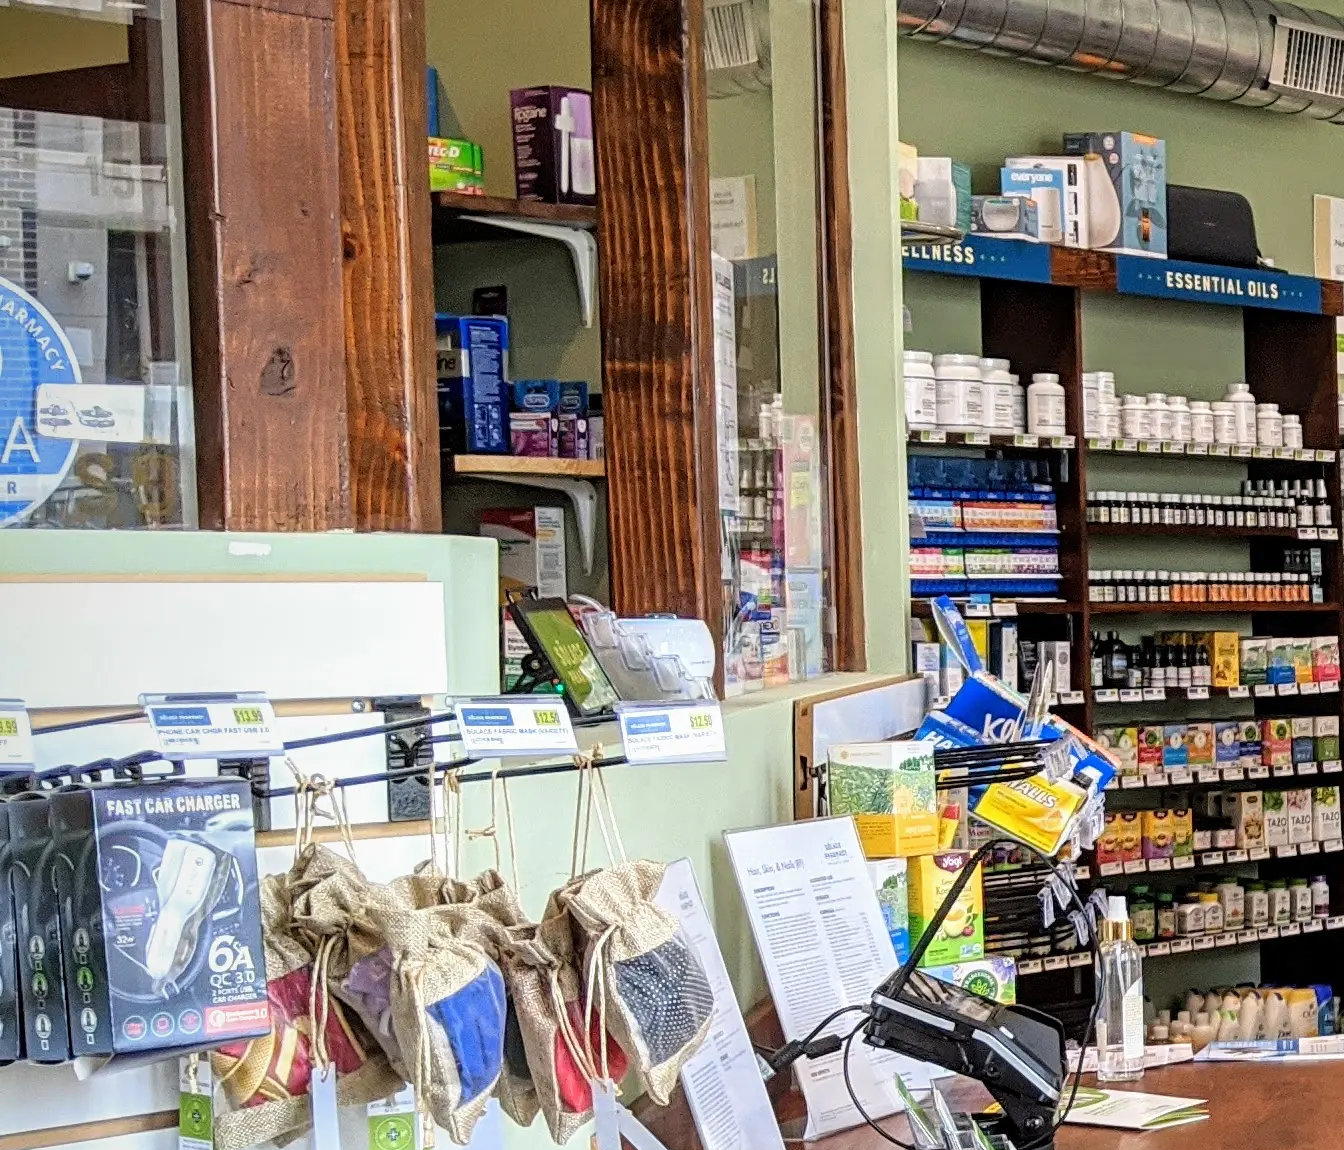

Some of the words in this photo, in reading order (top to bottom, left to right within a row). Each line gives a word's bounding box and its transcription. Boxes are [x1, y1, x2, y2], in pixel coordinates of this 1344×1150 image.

[1011, 171, 1053, 184] everyone
[902, 245, 974, 265] ELLNESS
[1166, 270, 1243, 296] ESSENTIAL
[1247, 278, 1279, 300] OILS
[234, 709, 263, 724] $13.99
[535, 711, 560, 725] $12.50
[690, 715, 713, 728] $12.50
[107, 799, 142, 816] FAST
[145, 797, 172, 814] CAR
[176, 794, 240, 812] CHARGER
[1268, 818, 1287, 827] TAZO
[1291, 816, 1310, 826] TAZO
[1321, 812, 1340, 822] TAZO
[943, 856, 962, 868] yogi
[210, 973, 232, 988] QC
[235, 971, 255, 984] 3.0
